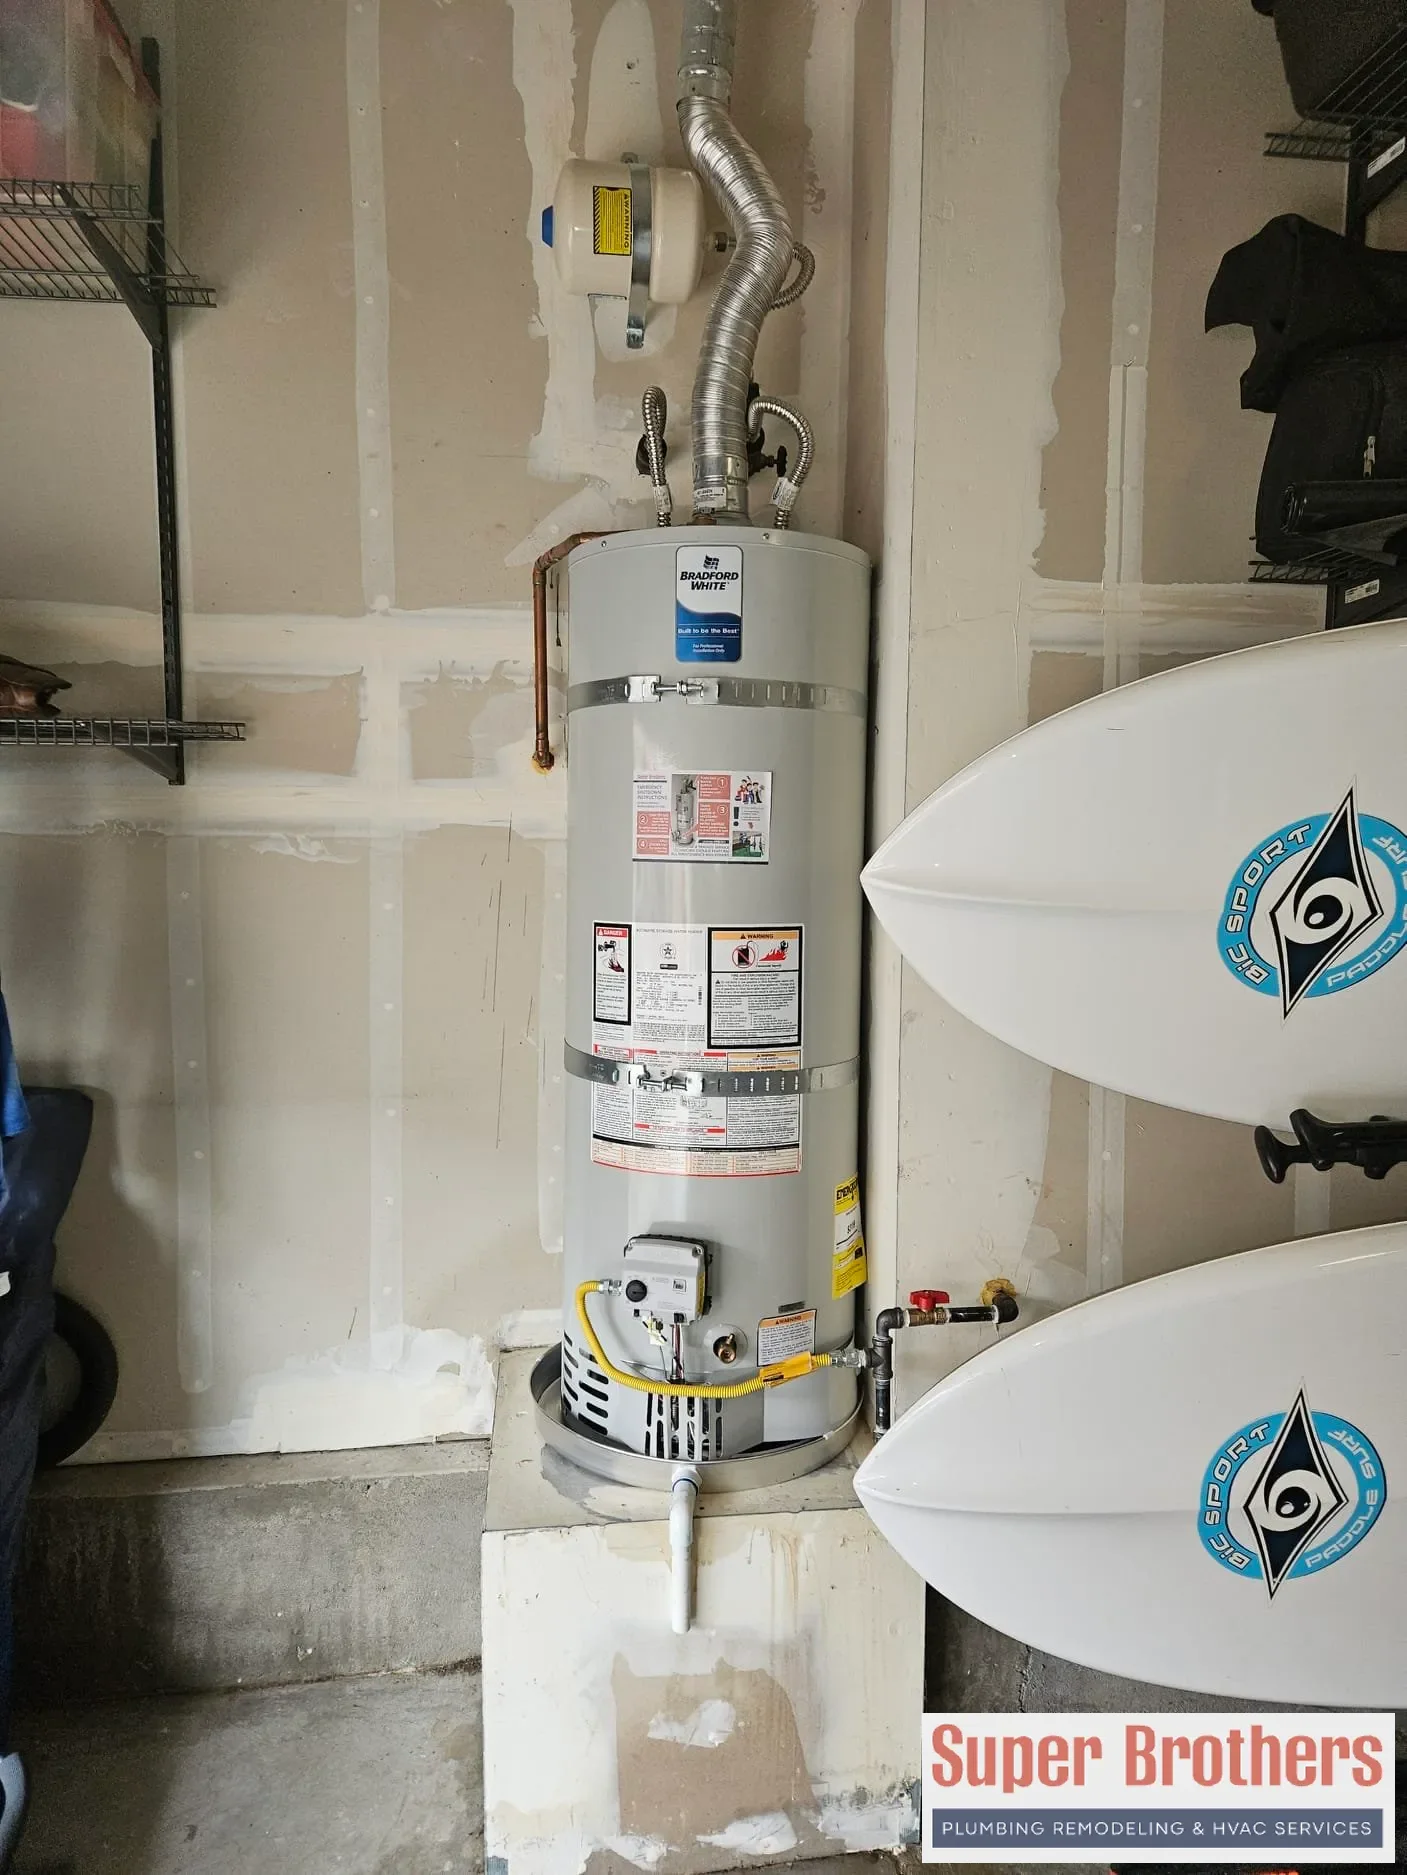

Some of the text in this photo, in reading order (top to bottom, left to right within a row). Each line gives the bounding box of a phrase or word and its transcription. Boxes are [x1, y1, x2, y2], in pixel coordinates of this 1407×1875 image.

[680, 571, 739, 581] BRADFORD
[691, 581, 727, 591] WHITE
[1225, 824, 1311, 933] SPORT
[1204, 1422, 1269, 1525] SPORT
[1305, 1430, 1378, 1568] PADDLE SURF
